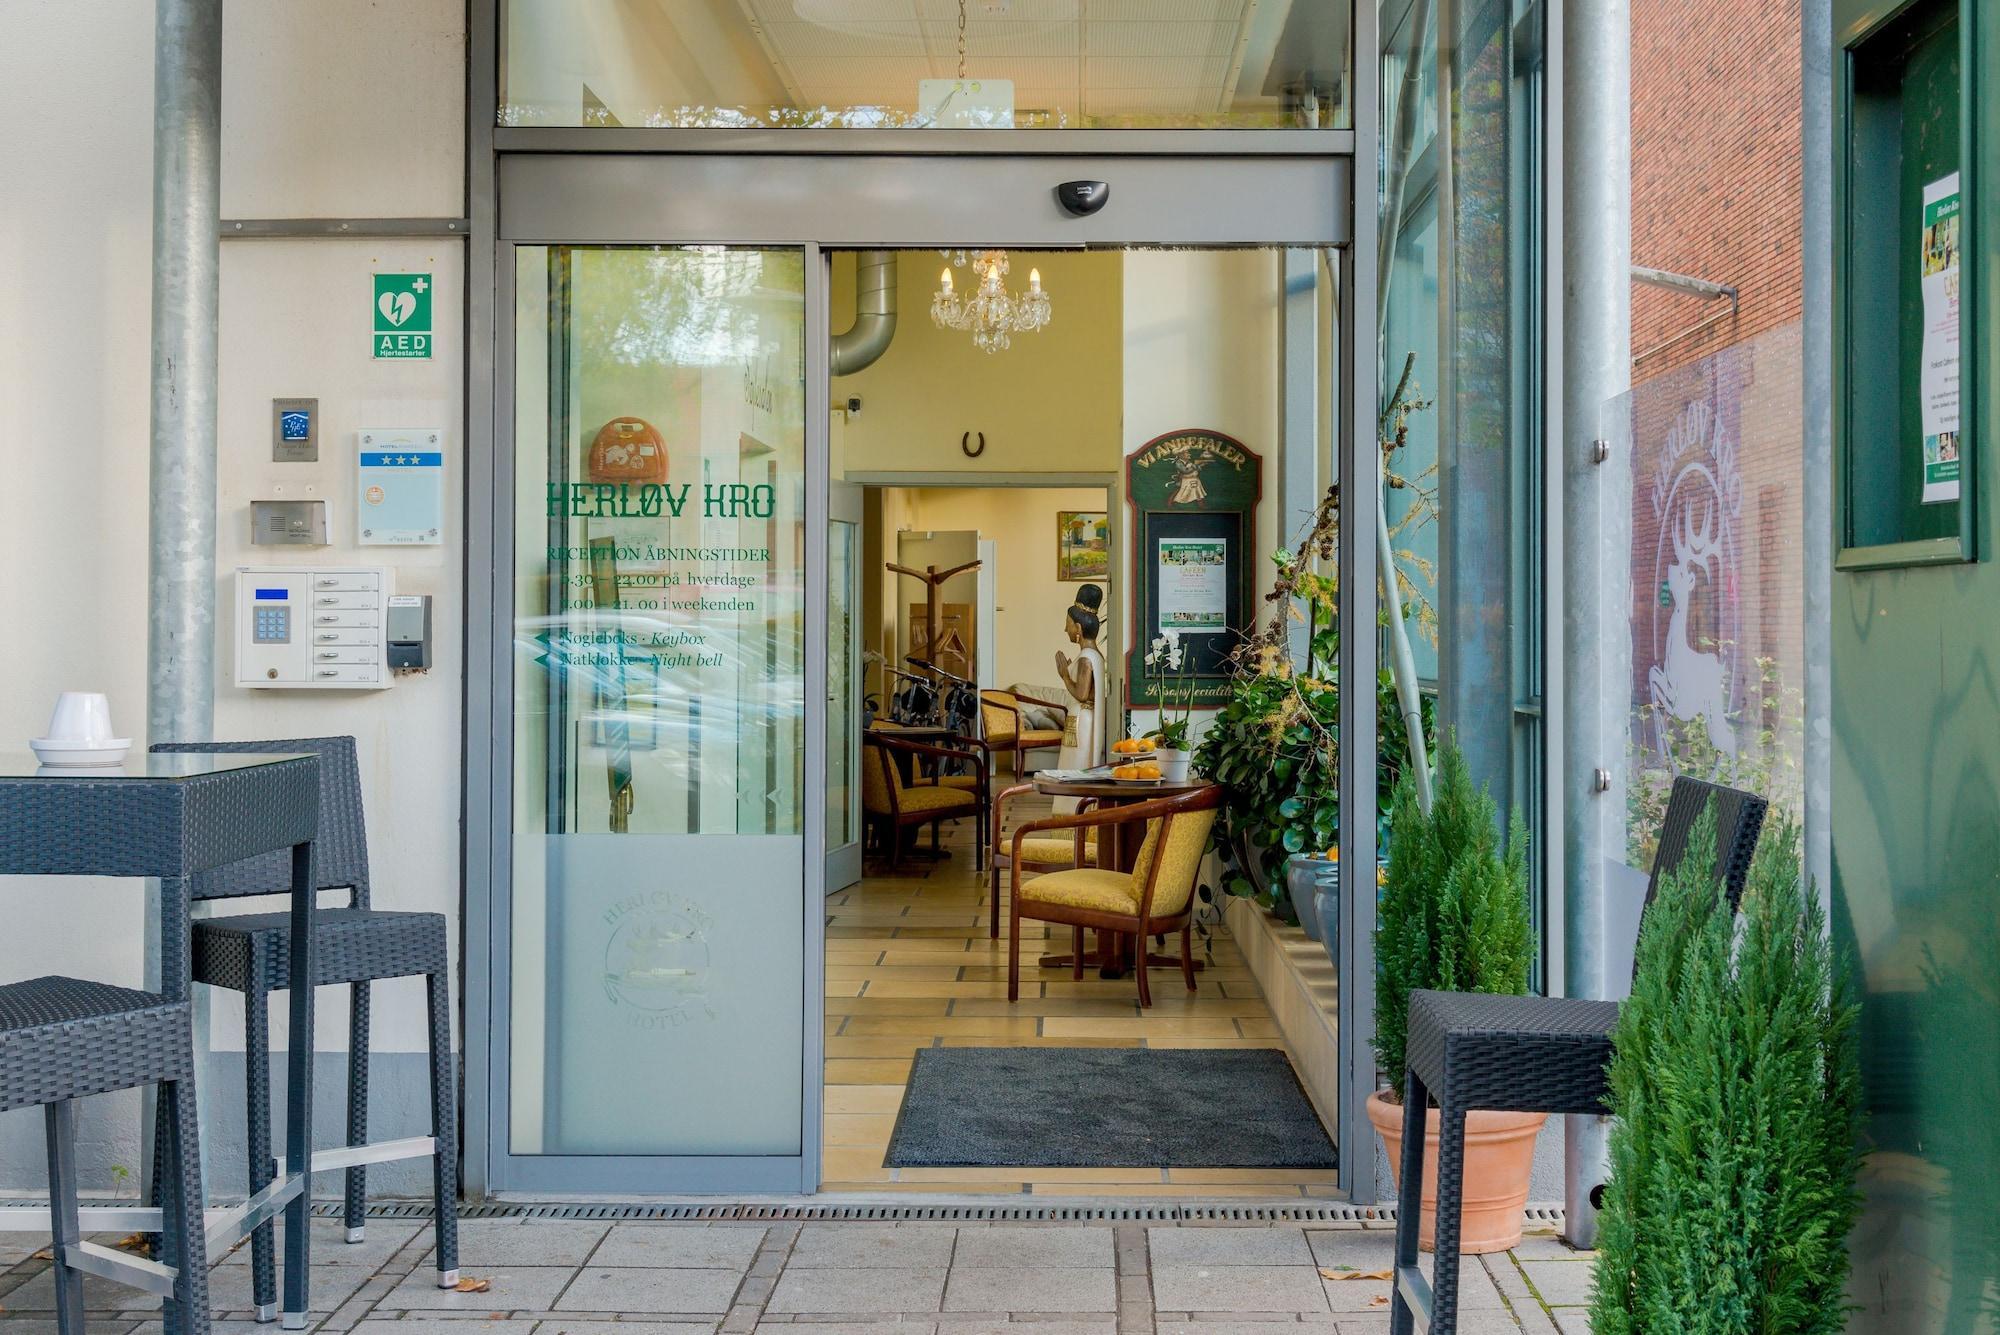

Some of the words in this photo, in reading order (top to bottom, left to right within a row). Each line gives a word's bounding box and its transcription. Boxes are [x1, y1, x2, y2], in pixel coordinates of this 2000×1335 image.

[380, 335, 426, 350] AED
[380, 350, 426, 358] Hjertestarter
[1136, 451, 1156, 469] VI
[546, 482, 692, 518] HERLØV
[547, 547, 640, 561] RECEPTION
[644, 544, 771, 561] ÅBNINGSTIDER
[614, 575, 656, 586] 22.00
[663, 571, 680, 588] på
[687, 571, 756, 589] hverdage
[663, 597, 667, 610] i
[671, 597, 755, 611] weekenden
[651, 631, 707, 648] Keybox
[560, 652, 635, 666] Natklokke
[650, 652, 692, 669] Night
[696, 652, 723, 667] bell
